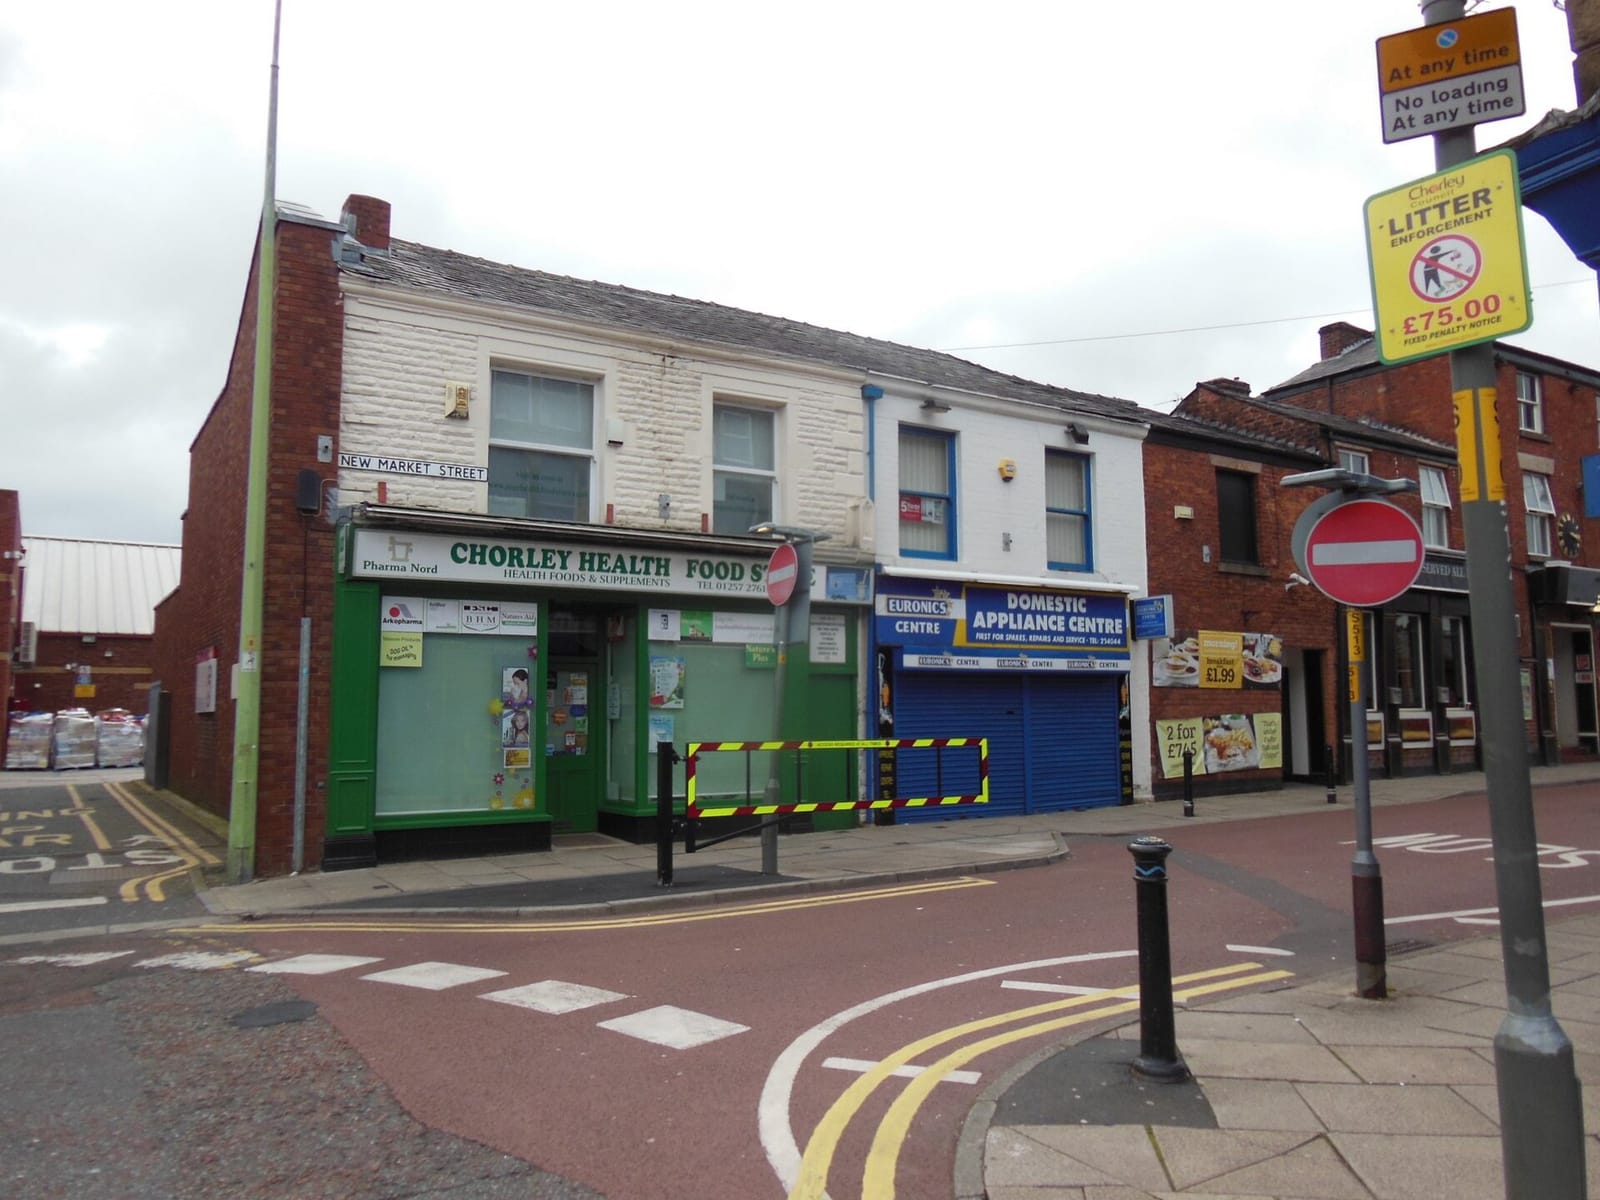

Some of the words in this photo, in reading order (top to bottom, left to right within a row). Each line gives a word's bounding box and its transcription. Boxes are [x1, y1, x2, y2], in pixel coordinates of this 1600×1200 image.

[1389, 66, 1411, 83] At
[1420, 57, 1455, 75] any
[1464, 45, 1510, 65] time
[1395, 96, 1423, 112] No
[1432, 77, 1508, 104] loading
[1392, 115, 1416, 132] At
[1423, 108, 1459, 125] any
[1468, 97, 1514, 115] time
[1408, 175, 1465, 201] Chorley
[1388, 187, 1493, 236] LITTER
[1390, 207, 1493, 248] ENFORCEMENT
[1403, 294, 1501, 335] £75.00
[1404, 333, 1428, 346] FIXED
[1429, 324, 1467, 340] PENALTY
[1469, 315, 1502, 329] NOTICE
[340, 455, 371, 468] NEW
[378, 459, 431, 474] MARKET
[439, 465, 485, 480] STREET
[363, 560, 407, 573] Pharma
[410, 564, 438, 574] Nord
[450, 542, 572, 570] CHORLEY
[578, 551, 671, 577] HEALTH
[686, 559, 745, 582] FOOD
[503, 569, 546, 580] HEALTH
[549, 572, 586, 583] FOODS
[588, 574, 597, 583] &
[599, 575, 671, 587] SUPPLEMENTS
[697, 581, 714, 590] TEL
[716, 582, 743, 592] 01257
[746, 585, 766, 593] 2761
[888, 599, 946, 614] EURONICS
[1007, 592, 1087, 613] DOMESTIC
[383, 617, 423, 625] Arkopharma
[895, 620, 940, 635] CENTRE
[973, 611, 1065, 632] APPLIANCE
[1068, 616, 1123, 634] CENTRE
[975, 632, 991, 640] FIRST
[992, 633, 1004, 641] FOR
[1029, 634, 1051, 642] REPAIRS
[1207, 657, 1235, 665] breakfast
[1206, 667, 1236, 683] £1.99
[1167, 726, 1174, 740] 2
[1178, 723, 1197, 740] for
